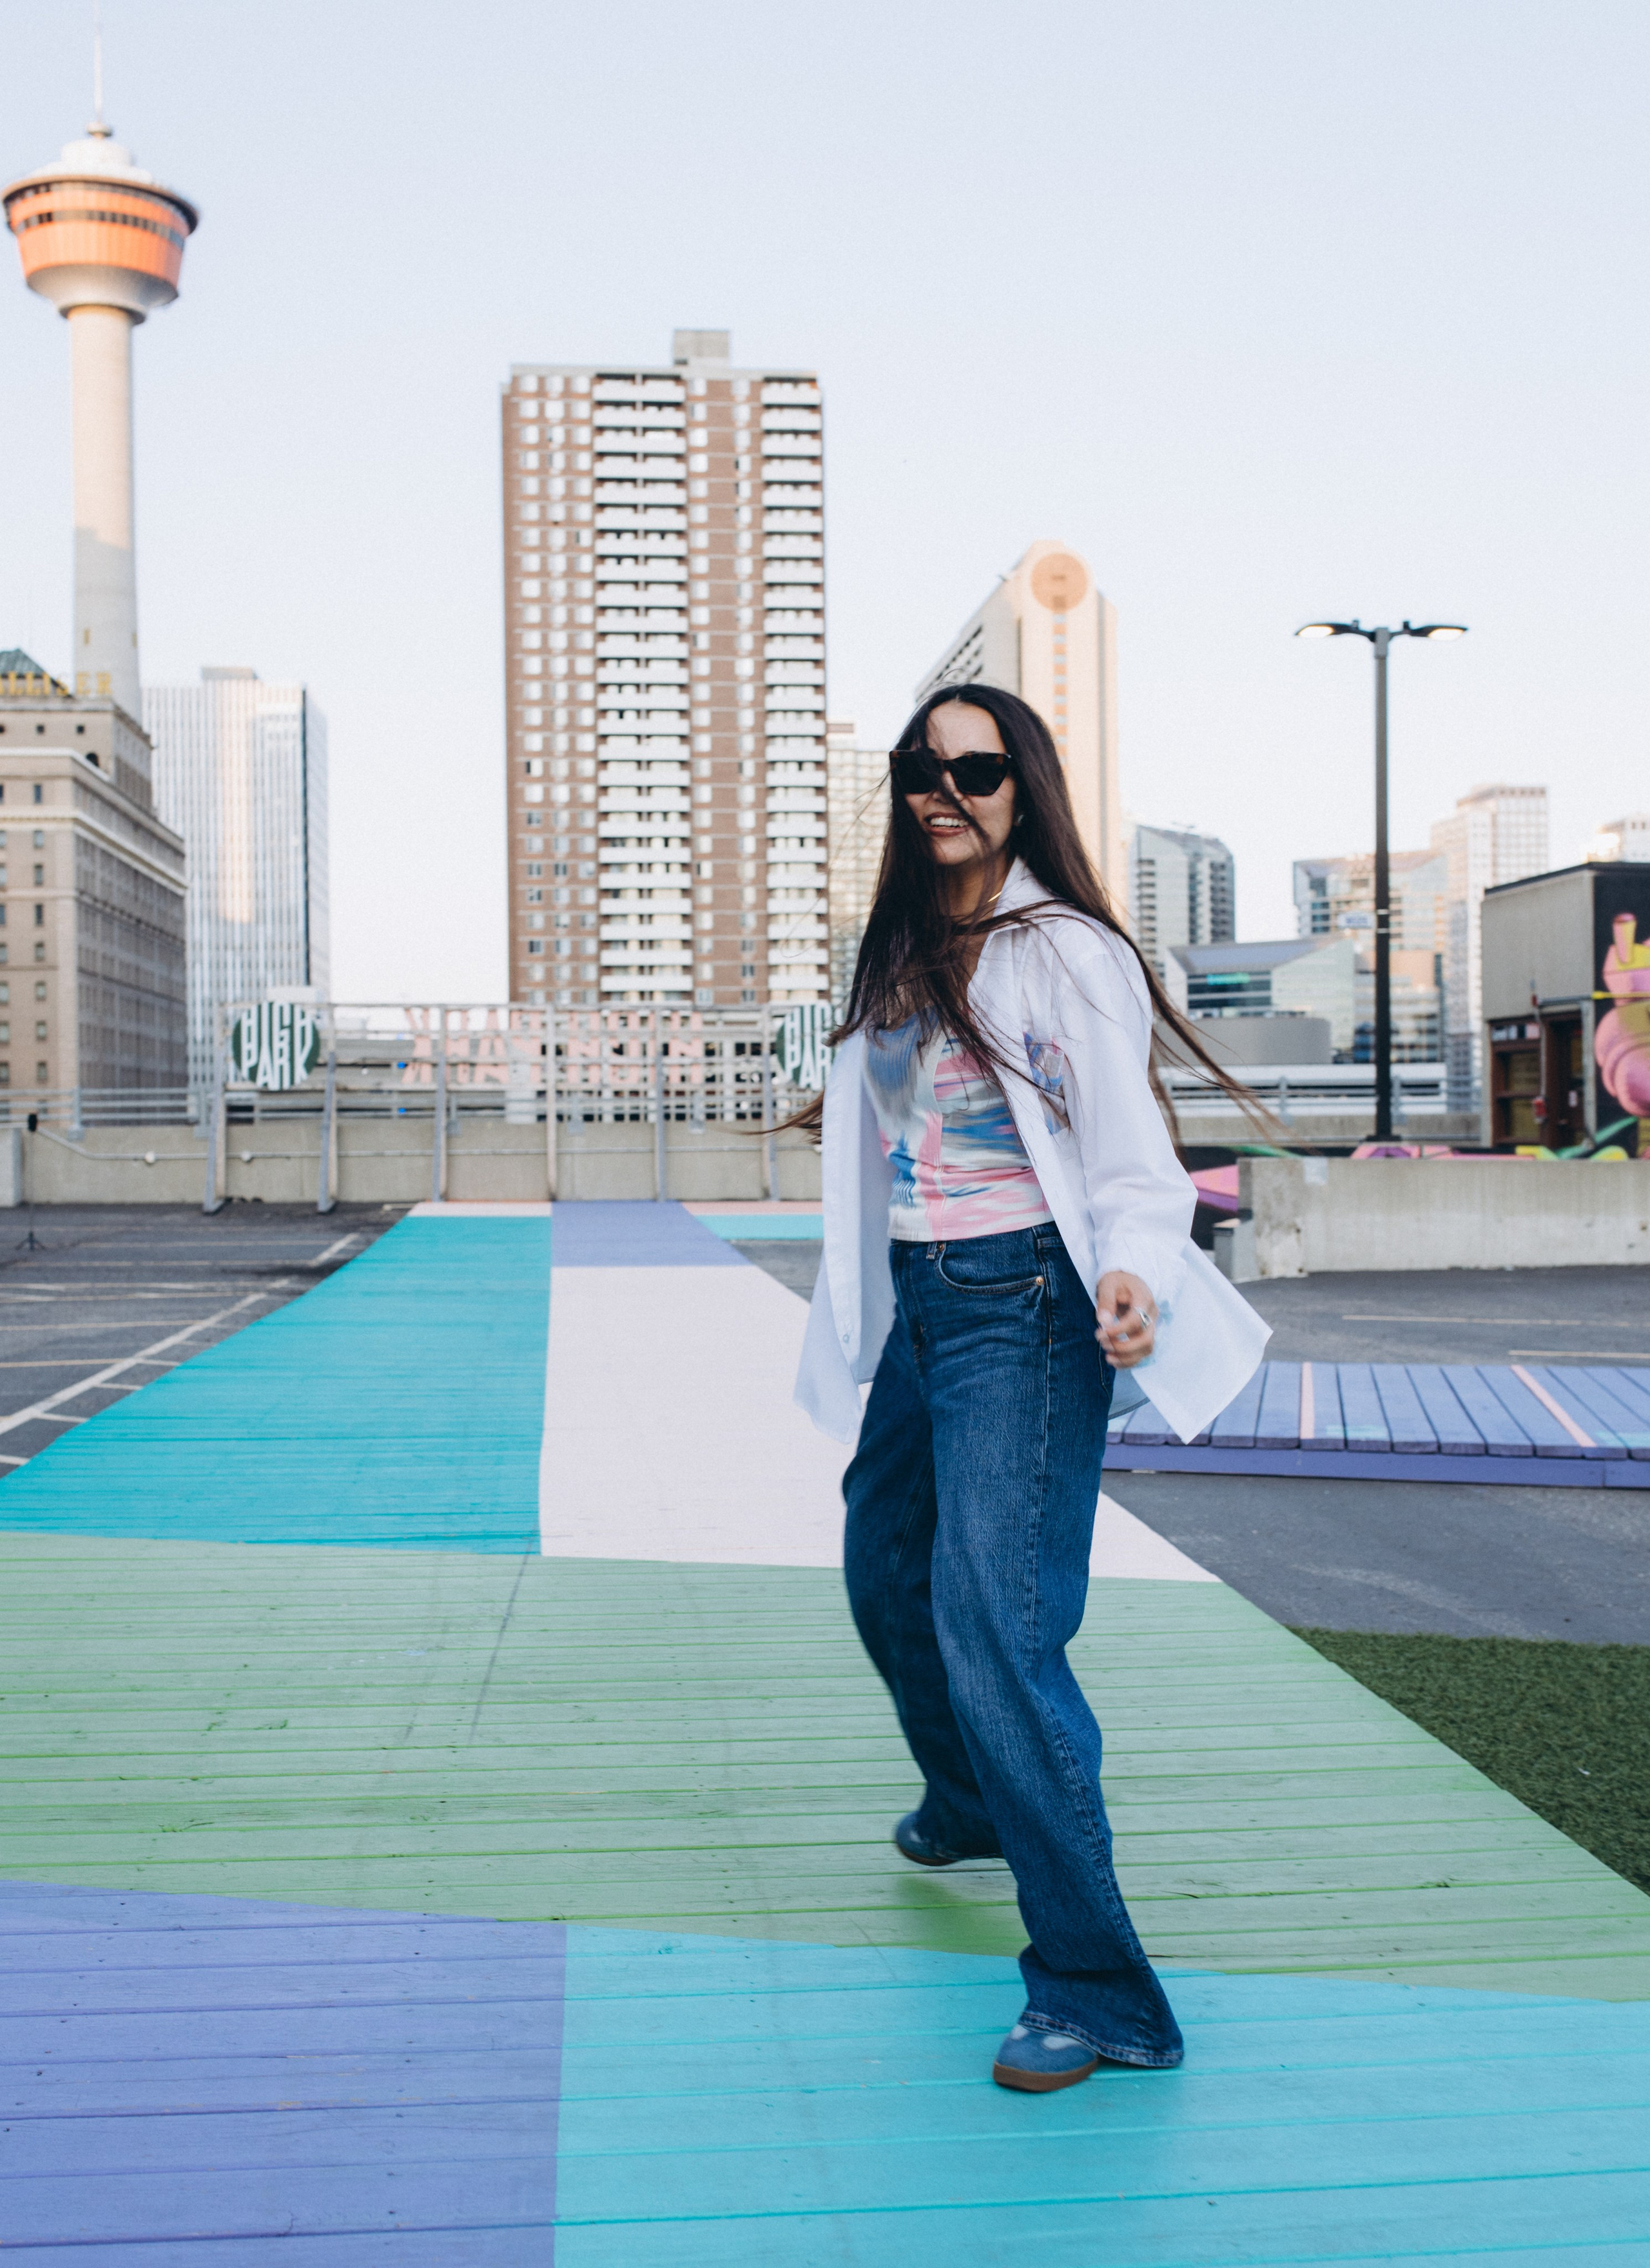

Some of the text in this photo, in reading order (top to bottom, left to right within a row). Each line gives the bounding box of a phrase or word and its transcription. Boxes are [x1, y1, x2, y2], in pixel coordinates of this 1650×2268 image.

[241, 1001, 314, 1044] HIGH
[241, 1043, 313, 1090] PARK
[785, 1043, 832, 1090] PAR
